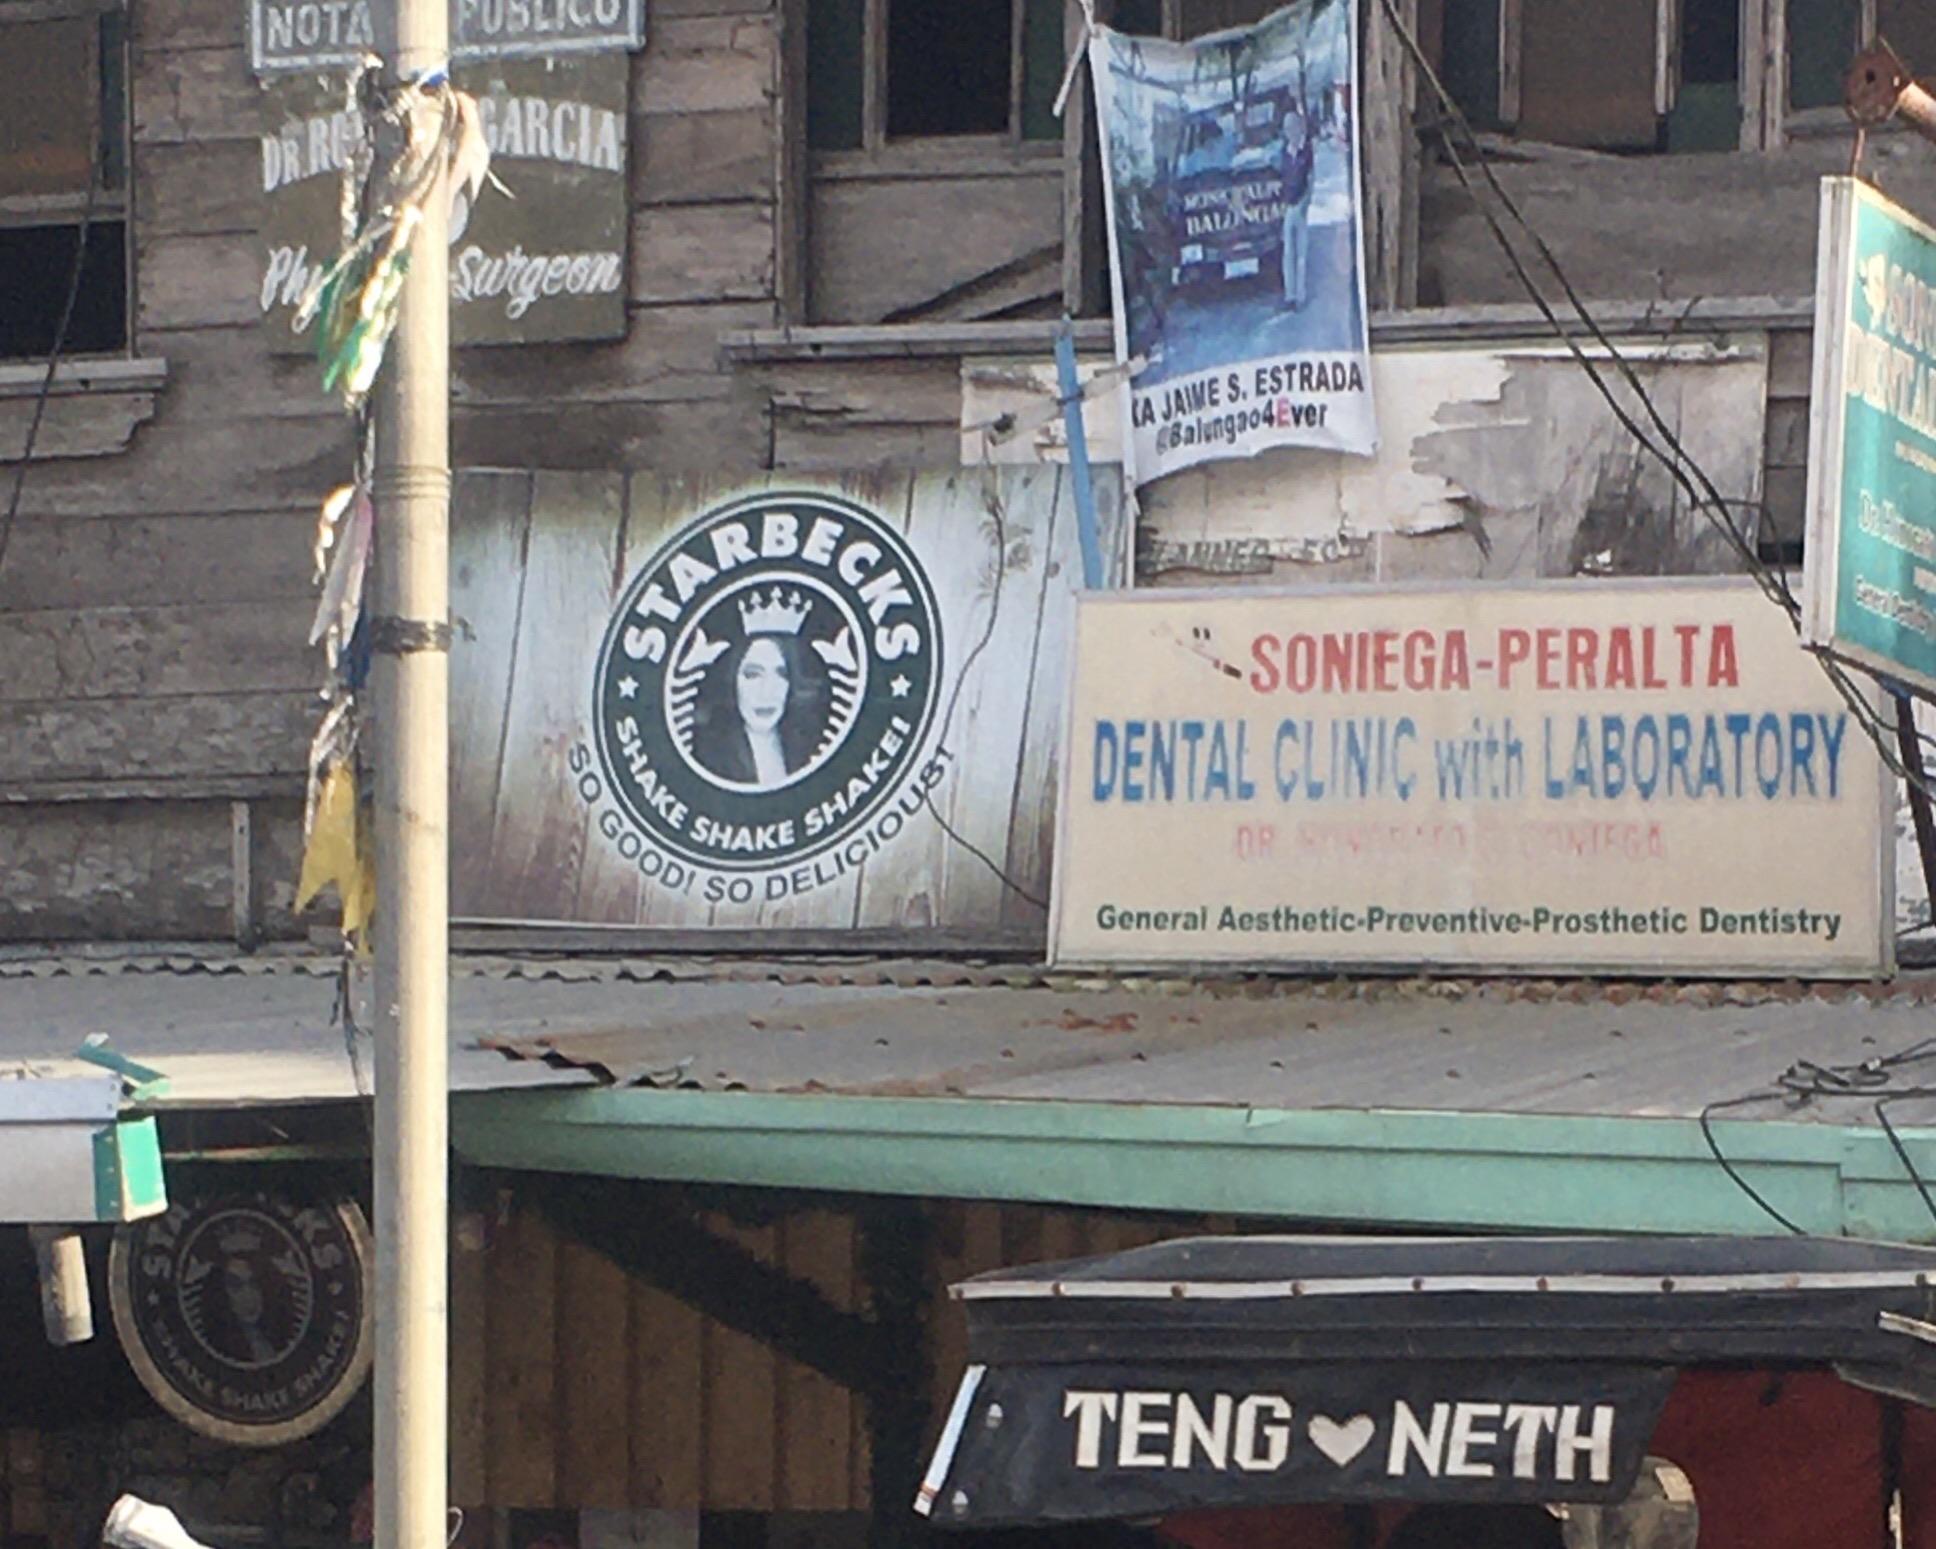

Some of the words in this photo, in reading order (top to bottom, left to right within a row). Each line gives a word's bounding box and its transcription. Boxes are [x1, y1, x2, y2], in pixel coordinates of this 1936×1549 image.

[266, 1, 375, 50] NOTA
[478, 96, 621, 171] GARCIA
[451, 245, 622, 320] Surgeon
[1161, 376, 1220, 421] JAIME
[1227, 373, 1247, 403] S.
[1255, 361, 1364, 398] ESTRADA
[623, 512, 920, 664] STARBECKS
[1250, 624, 1739, 694] SONIEGA-PERALTA
[615, 715, 690, 830] SHAKE
[689, 815, 795, 852] SHAKE
[1093, 719, 1255, 802] DENTAL
[1274, 716, 1416, 801] CLINIC
[1433, 717, 1524, 799] with
[1543, 711, 1847, 800] LABORATORY
[568, 742, 602, 804] SO
[599, 808, 697, 896] GOOD!
[703, 875, 754, 904] SO
[1096, 904, 1207, 931] General
[1217, 904, 1687, 933] Aesthetic-Preventive-Prosthetic
[1699, 906, 1841, 940] Dentistry
[1063, 1390, 1293, 1471] TENG
[1386, 1400, 1615, 1482] NETH
